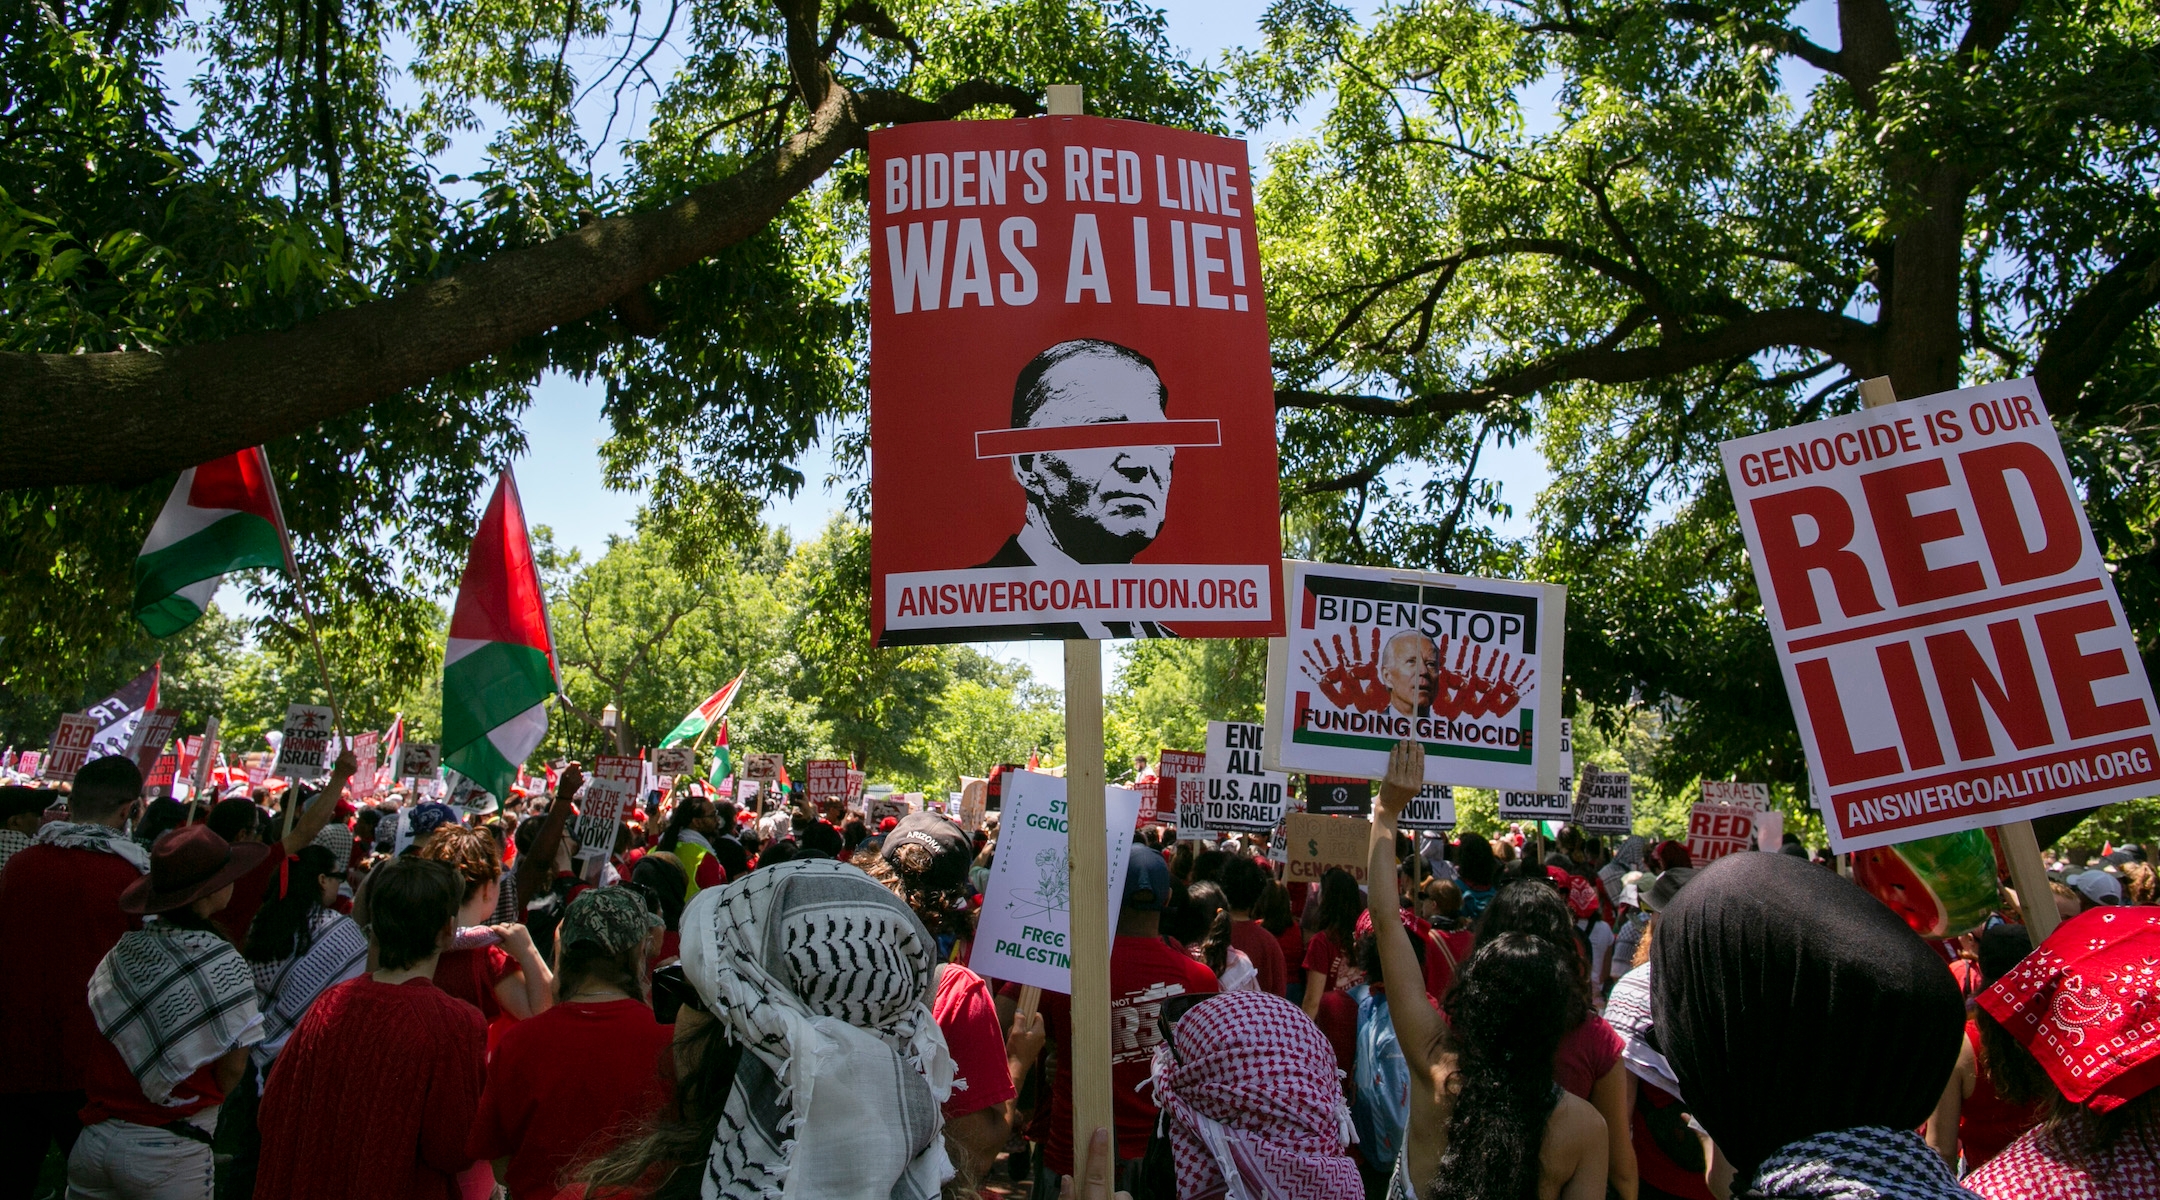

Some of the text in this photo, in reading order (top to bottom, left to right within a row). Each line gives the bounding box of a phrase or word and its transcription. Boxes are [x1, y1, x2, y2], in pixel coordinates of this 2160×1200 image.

[886, 146, 1241, 217] BIDEN'S RED LINE
[886, 213, 1249, 315] WAS A LIE!
[1740, 396, 2041, 486] GENOCIDE IS OUR
[1750, 441, 2082, 630] RED
[897, 578, 1258, 617] ANSWERCOALITION.ORG
[1319, 597, 1520, 645] BIDEN STOP
[1795, 600, 2151, 786] LINE
[57, 723, 95, 749] RED
[286, 728, 327, 739] STOP
[1300, 709, 1412, 737] FUNDING
[1416, 718, 1533, 749] GENOCIDE
[283, 737, 326, 752] ARMING
[280, 750, 321, 766] ISRAEL
[1186, 756, 1199, 765] RED
[1227, 750, 1265, 776] ALL
[624, 766, 639, 778] ON
[810, 768, 846, 778] SIEGE ON
[1161, 763, 1183, 778] WAS
[1614, 776, 1628, 784] OFF
[810, 778, 847, 793] GAZA
[1181, 781, 1197, 791] END
[1209, 779, 1243, 801] U.S.
[1249, 781, 1282, 805] AID
[1703, 781, 1762, 800] ISRAEL
[1848, 747, 2153, 827] ANSWERCOALITION.ORG
[588, 788, 602, 800] END
[604, 789, 621, 803] THE
[1506, 792, 1568, 808] OCCUPIED!
[584, 800, 618, 819] SIEGE
[1049, 799, 1068, 814] ST
[1181, 804, 1192, 813] ON
[1207, 802, 1223, 818] TO
[1402, 800, 1440, 820] NOW!
[1611, 805, 1626, 814] THE
[1694, 804, 1728, 814] GENOCIDE
[580, 815, 613, 831] ON GAZA
[1026, 814, 1069, 833] GENO
[1295, 817, 1321, 838] NO
[1327, 819, 1368, 838] MORE
[1690, 812, 1751, 839] RED
[579, 825, 612, 849] NOW!
[906, 830, 942, 853] ARIZONA
[1000, 794, 1023, 873] PALESTINIAN
[1328, 840, 1358, 857] FOR
[1021, 925, 1066, 947] FREE
[995, 939, 1071, 969] PALESTIN
[1112, 998, 1130, 1008] NOT
